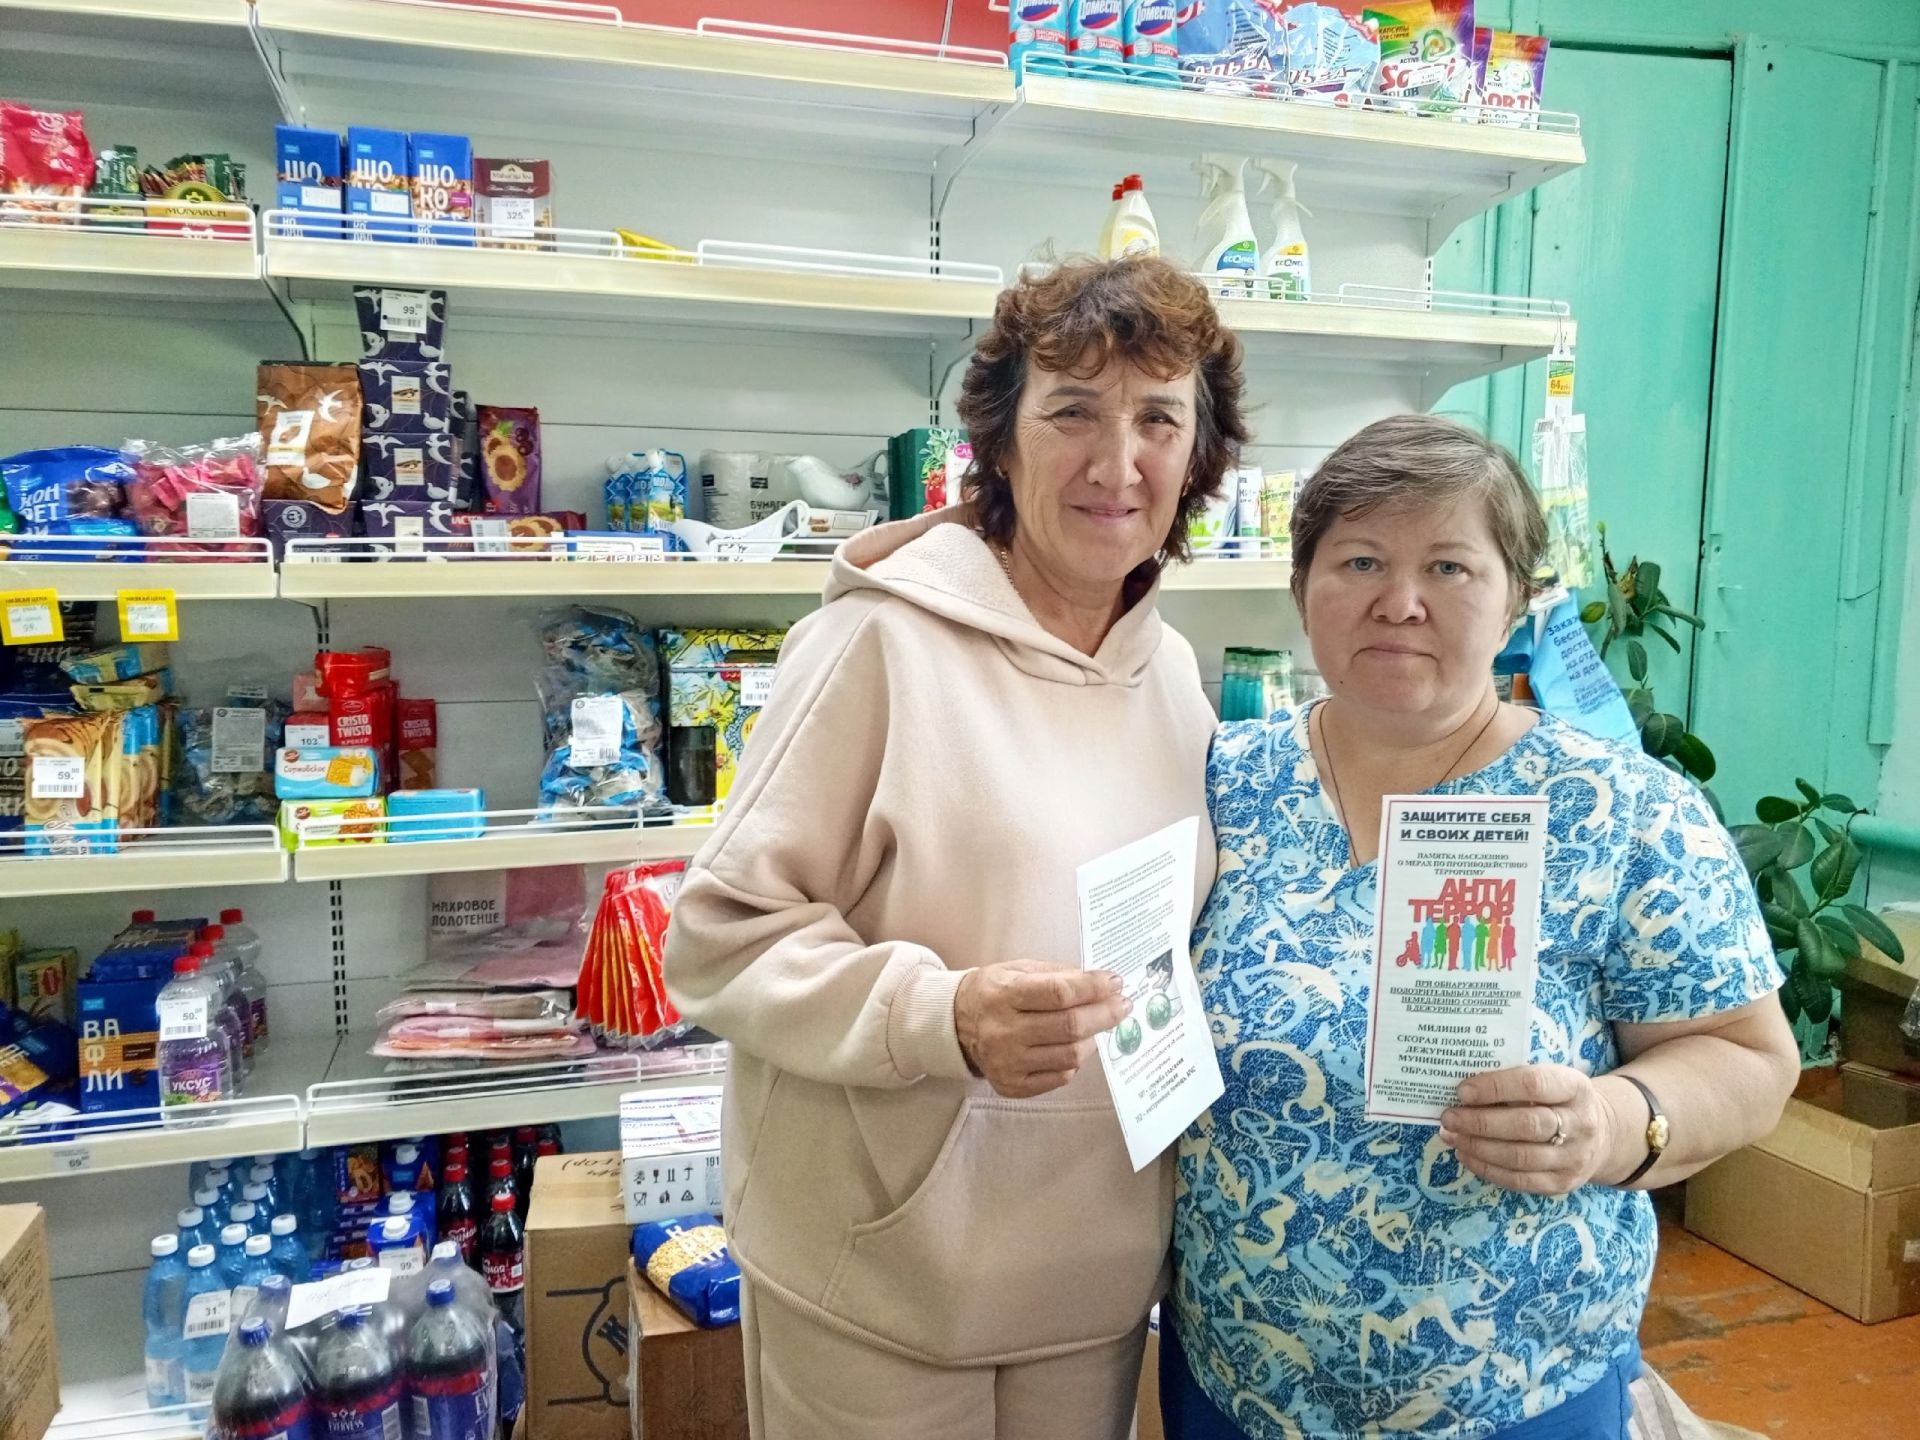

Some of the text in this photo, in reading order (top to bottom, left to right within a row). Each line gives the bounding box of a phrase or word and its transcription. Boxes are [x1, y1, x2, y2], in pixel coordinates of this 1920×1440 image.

[1409, 41, 1419, 56] 3
[1493, 70, 1501, 82] 3
[356, 158, 393, 181] ШО
[419, 164, 455, 187] ШО
[420, 187, 449, 209] КО
[337, 714, 369, 727] CRISTO
[337, 725, 372, 738] TWISTO
[1401, 811, 1531, 823] ЗАЩИТИТЕ СЕБЯ
[1401, 828, 1529, 842] И СВОИХ ДЕТЕЙ!
[1438, 878, 1516, 901] АНТИ
[431, 900, 496, 913] МАХРОВОЕ
[1408, 899, 1513, 924] ТЕРРОР
[431, 912, 500, 928] ПОЛОТЕНЦЕ
[1415, 980, 1498, 989] ПРИ ОБНАРУЖЕНИИ
[1418, 1024, 1488, 1034] МИЛИЦИЯ 02
[1397, 1035, 1505, 1047] СКОРАЯ ПОМОЩЬ 03
[1405, 1045, 1496, 1058] ДЕЖУРНЫЙ ЕДДС
[1398, 1055, 1501, 1068] МУНИЦИПАЛЬНОГО
[86, 1068, 123, 1092] ЛИ
[172, 1077, 212, 1092] УКСУС
